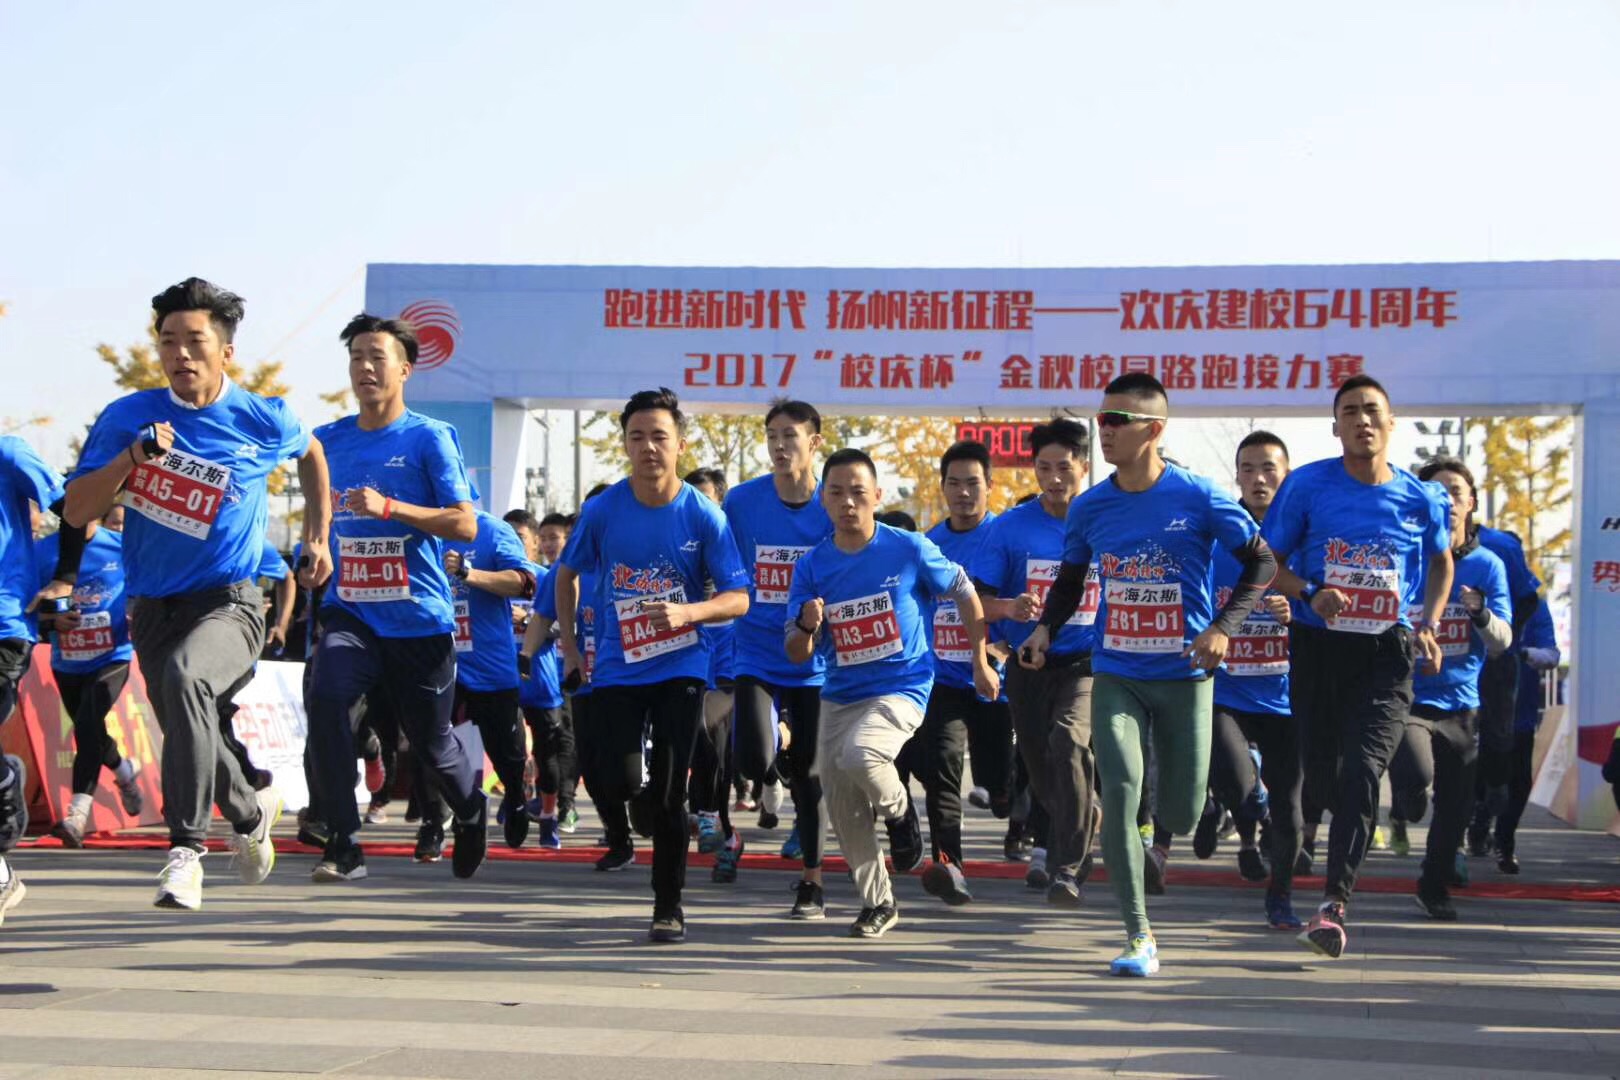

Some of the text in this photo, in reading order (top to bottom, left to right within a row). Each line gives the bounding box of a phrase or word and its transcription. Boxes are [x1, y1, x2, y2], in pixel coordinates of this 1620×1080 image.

[605, 290, 806, 330] 跑进新时代
[163, 452, 225, 485] 海尔斯
[146, 474, 217, 516] A5-01
[354, 541, 401, 555] 海尔斯
[351, 562, 404, 581] A4-01
[1124, 587, 1179, 602] 海尔斯
[841, 596, 889, 620] 海尔斯
[841, 616, 896, 647] A3-01
[1120, 610, 1179, 631] B1-01
[1233, 639, 1285, 658] A2-01
